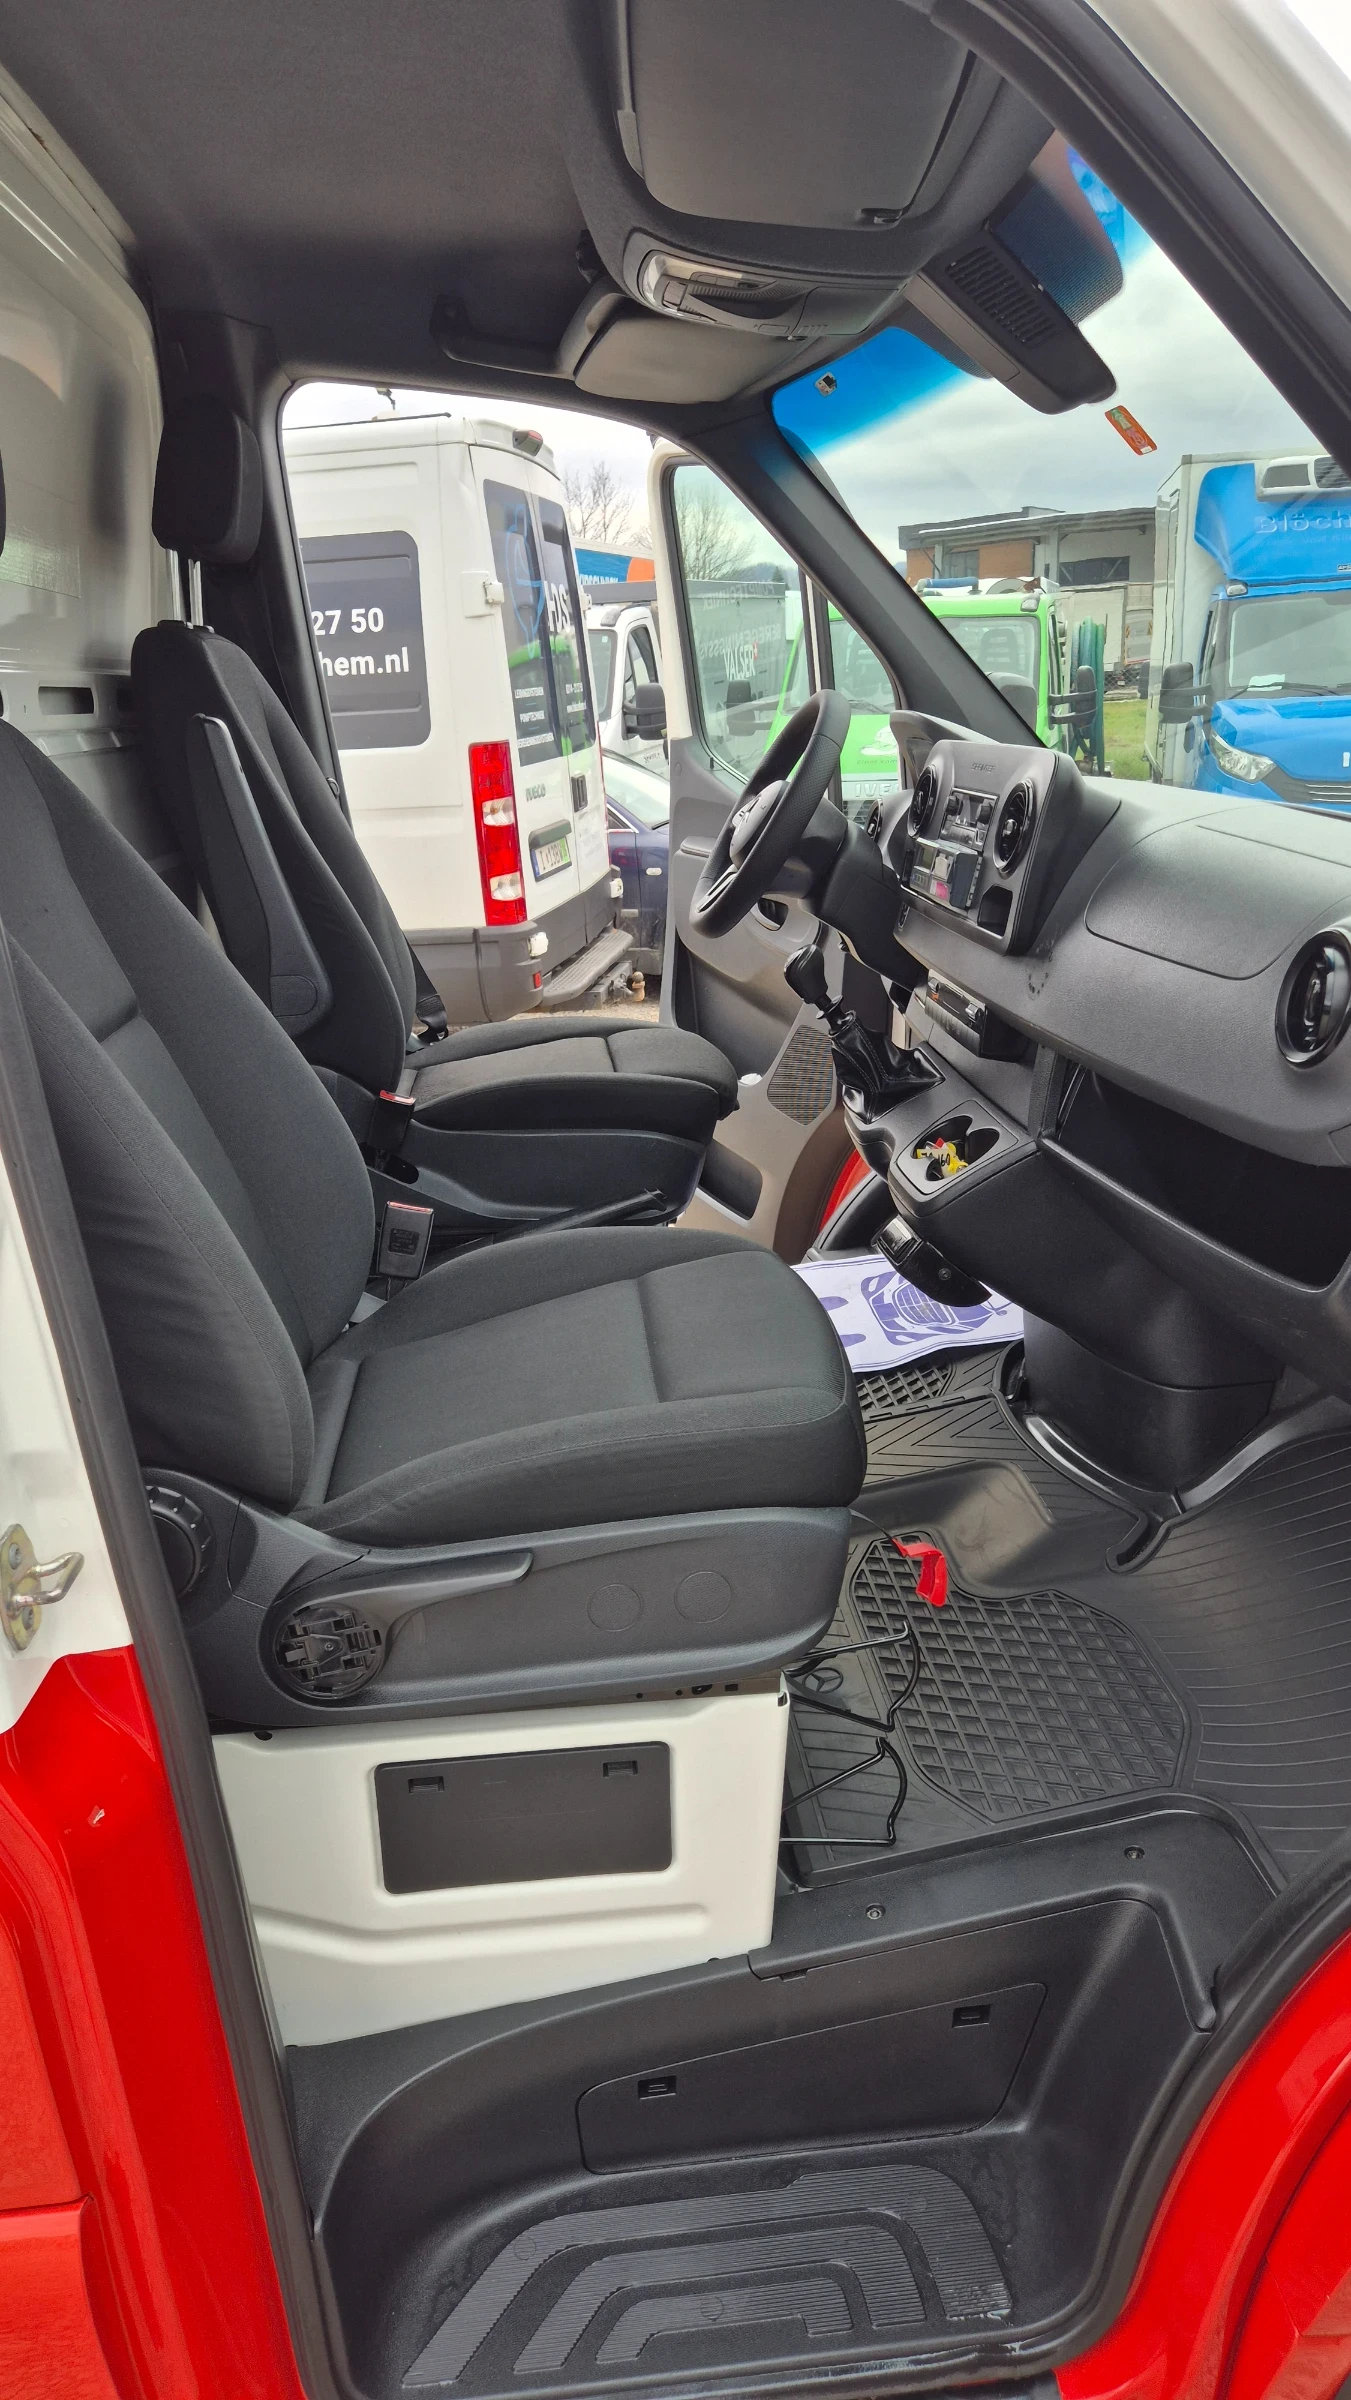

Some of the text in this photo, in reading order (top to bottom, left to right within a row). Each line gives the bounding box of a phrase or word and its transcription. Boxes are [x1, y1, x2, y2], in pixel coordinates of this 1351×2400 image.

[311, 607, 384, 636] 27 50
[318, 646, 409, 677] hem.nl
[723, 644, 756, 681] VALSER
